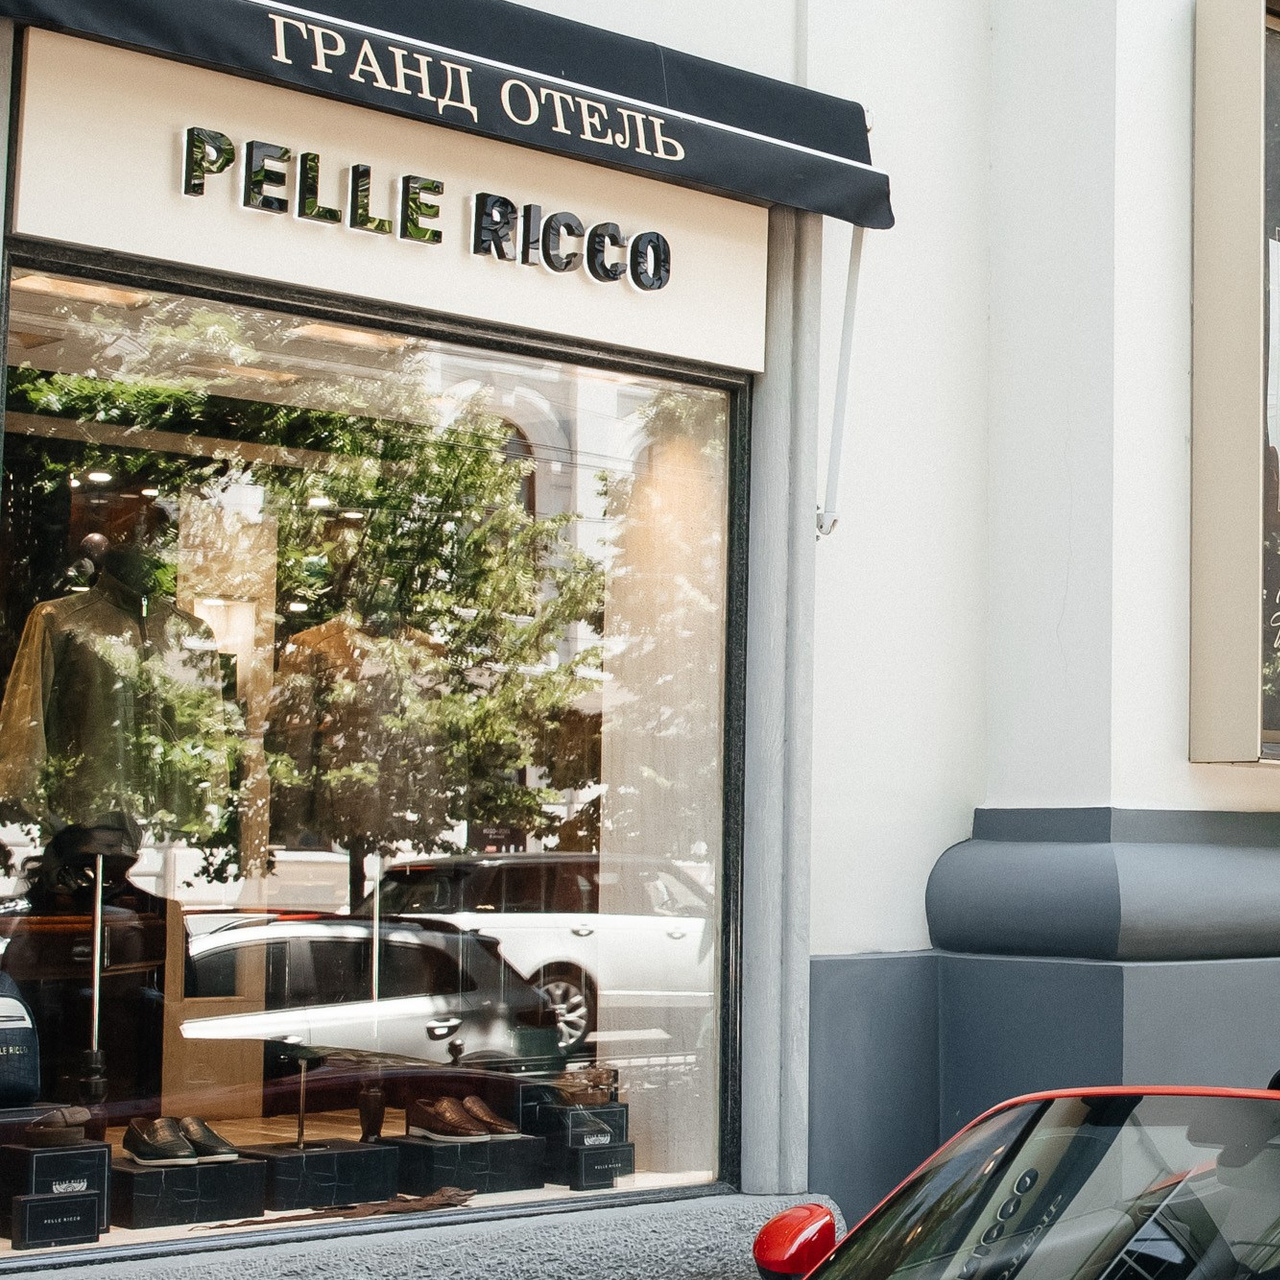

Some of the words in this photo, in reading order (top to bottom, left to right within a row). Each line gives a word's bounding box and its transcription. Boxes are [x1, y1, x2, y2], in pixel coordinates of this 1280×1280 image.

[268, 13, 479, 123] ГРАНД
[501, 79, 686, 162] ОТЕЛЬ
[182, 125, 445, 245] PELLE
[472, 191, 671, 292] RICCO
